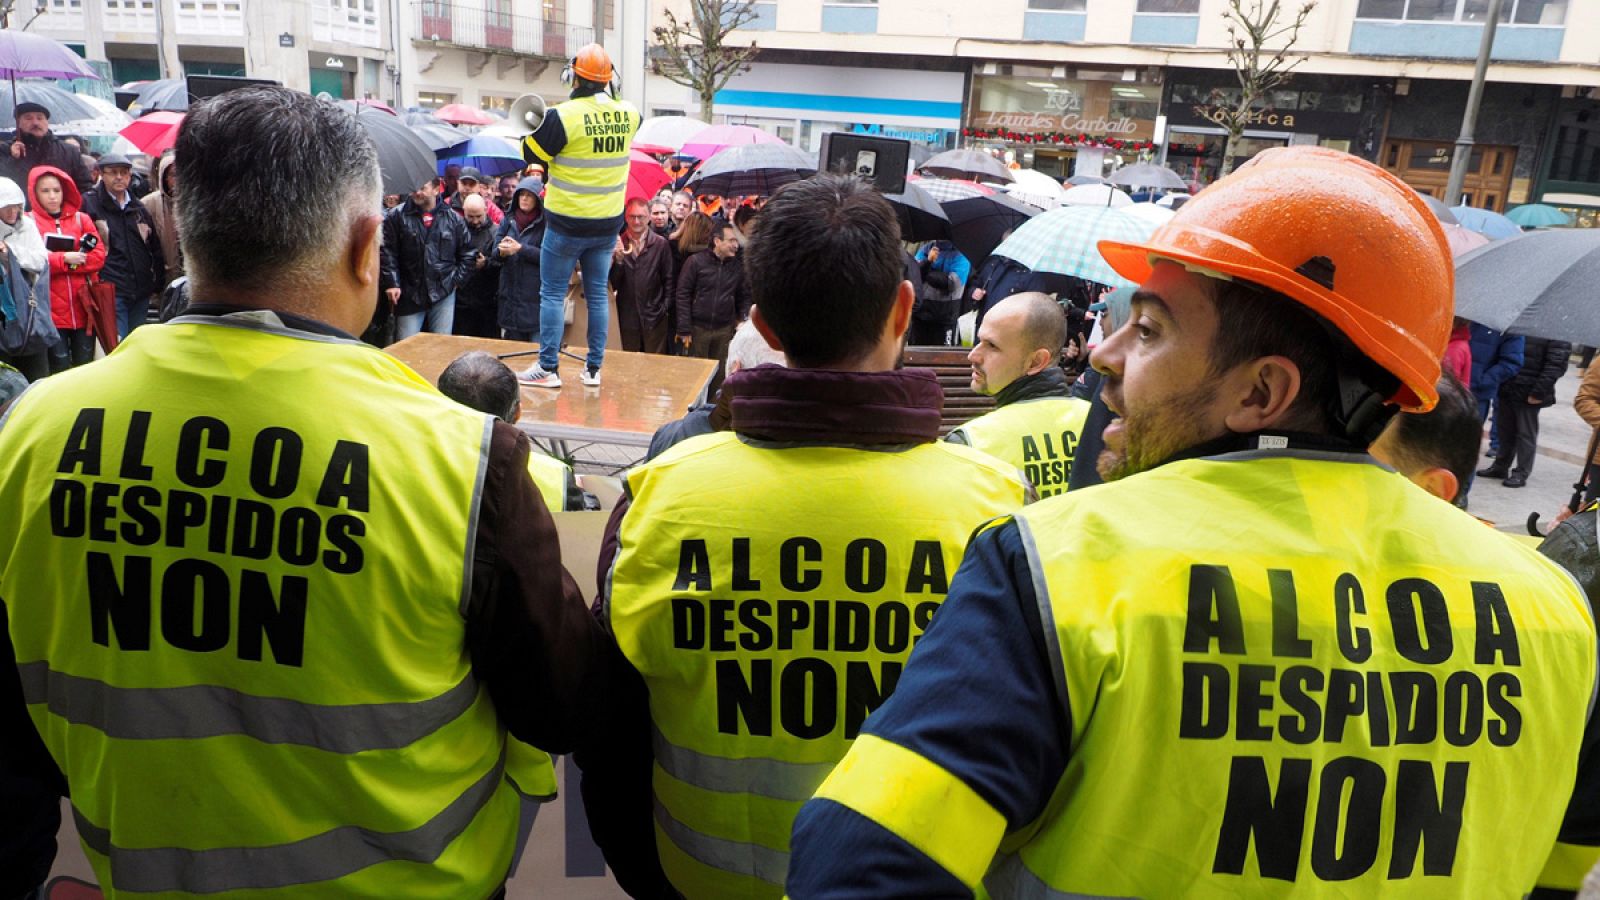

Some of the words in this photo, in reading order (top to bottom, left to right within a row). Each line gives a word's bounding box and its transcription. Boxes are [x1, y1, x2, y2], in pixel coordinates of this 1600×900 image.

[584, 110, 631, 125] ALCOA
[585, 123, 631, 137] DESPIDOS
[592, 136, 626, 154] NON
[985, 110, 1054, 130] Lourdes
[1061, 112, 1138, 135] Carballo
[55, 407, 371, 514] ALCOA
[49, 477, 367, 576] DESPIDOS
[671, 536, 949, 595] ALCOA
[85, 550, 309, 669] NON
[1182, 563, 1523, 667] ALCOA
[715, 656, 903, 741] NON
[1178, 661, 1523, 748] DESPIDOS
[1211, 754, 1471, 884] NON
